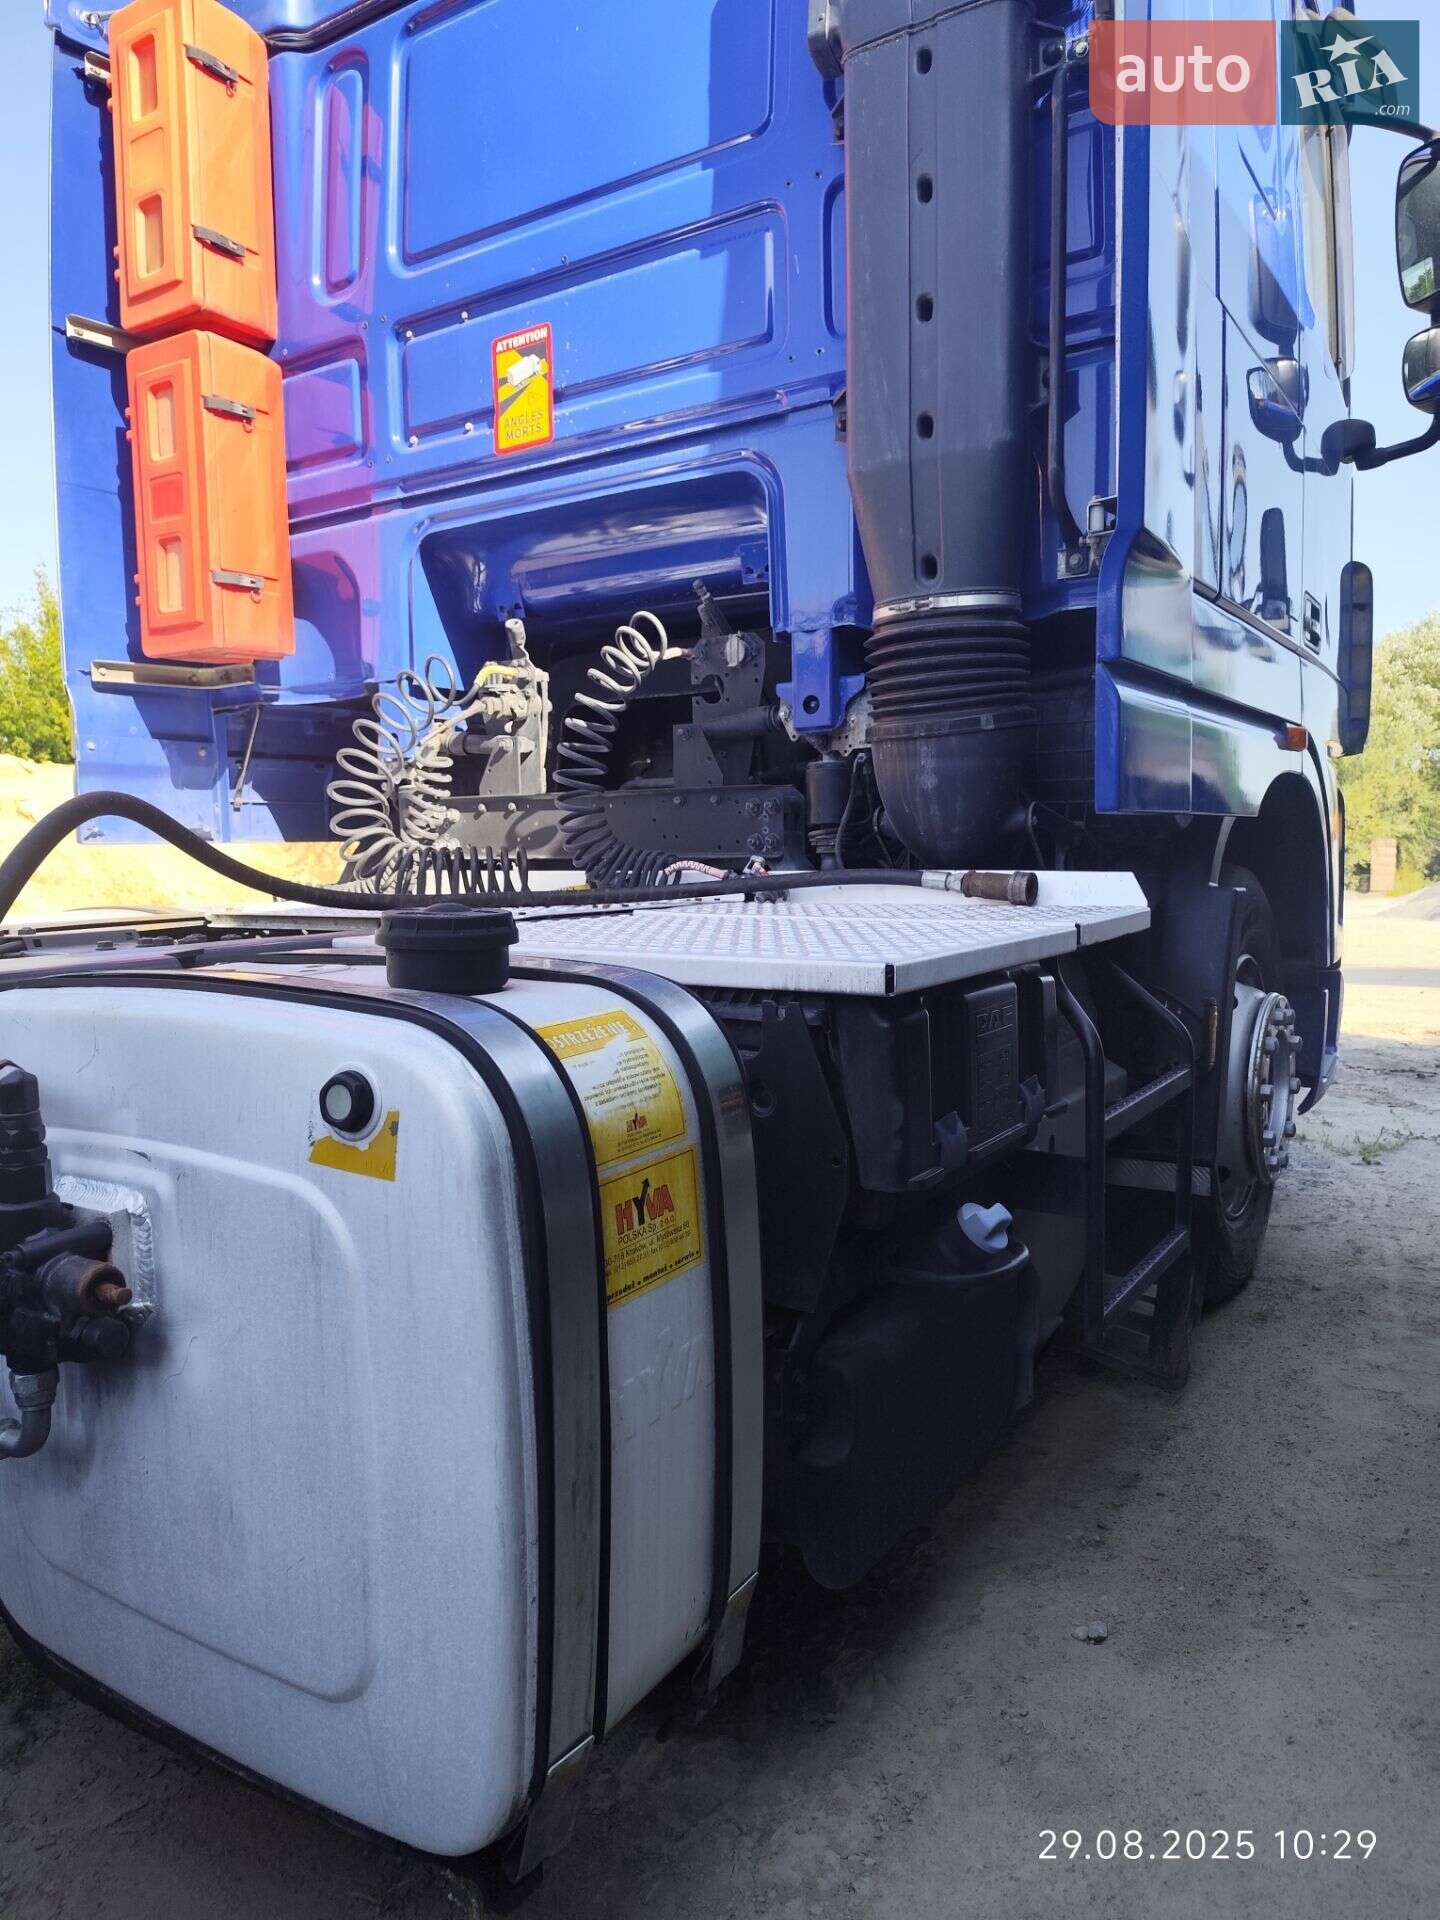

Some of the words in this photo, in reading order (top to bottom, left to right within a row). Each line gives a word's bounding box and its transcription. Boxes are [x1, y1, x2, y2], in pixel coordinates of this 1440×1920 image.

[496, 327, 548, 353] ATTENTION
[505, 409, 543, 428] ANGLES
[506, 423, 542, 440] MORTS
[615, 1178, 675, 1235] HYVA
[618, 1227, 646, 1244] POLSKA
